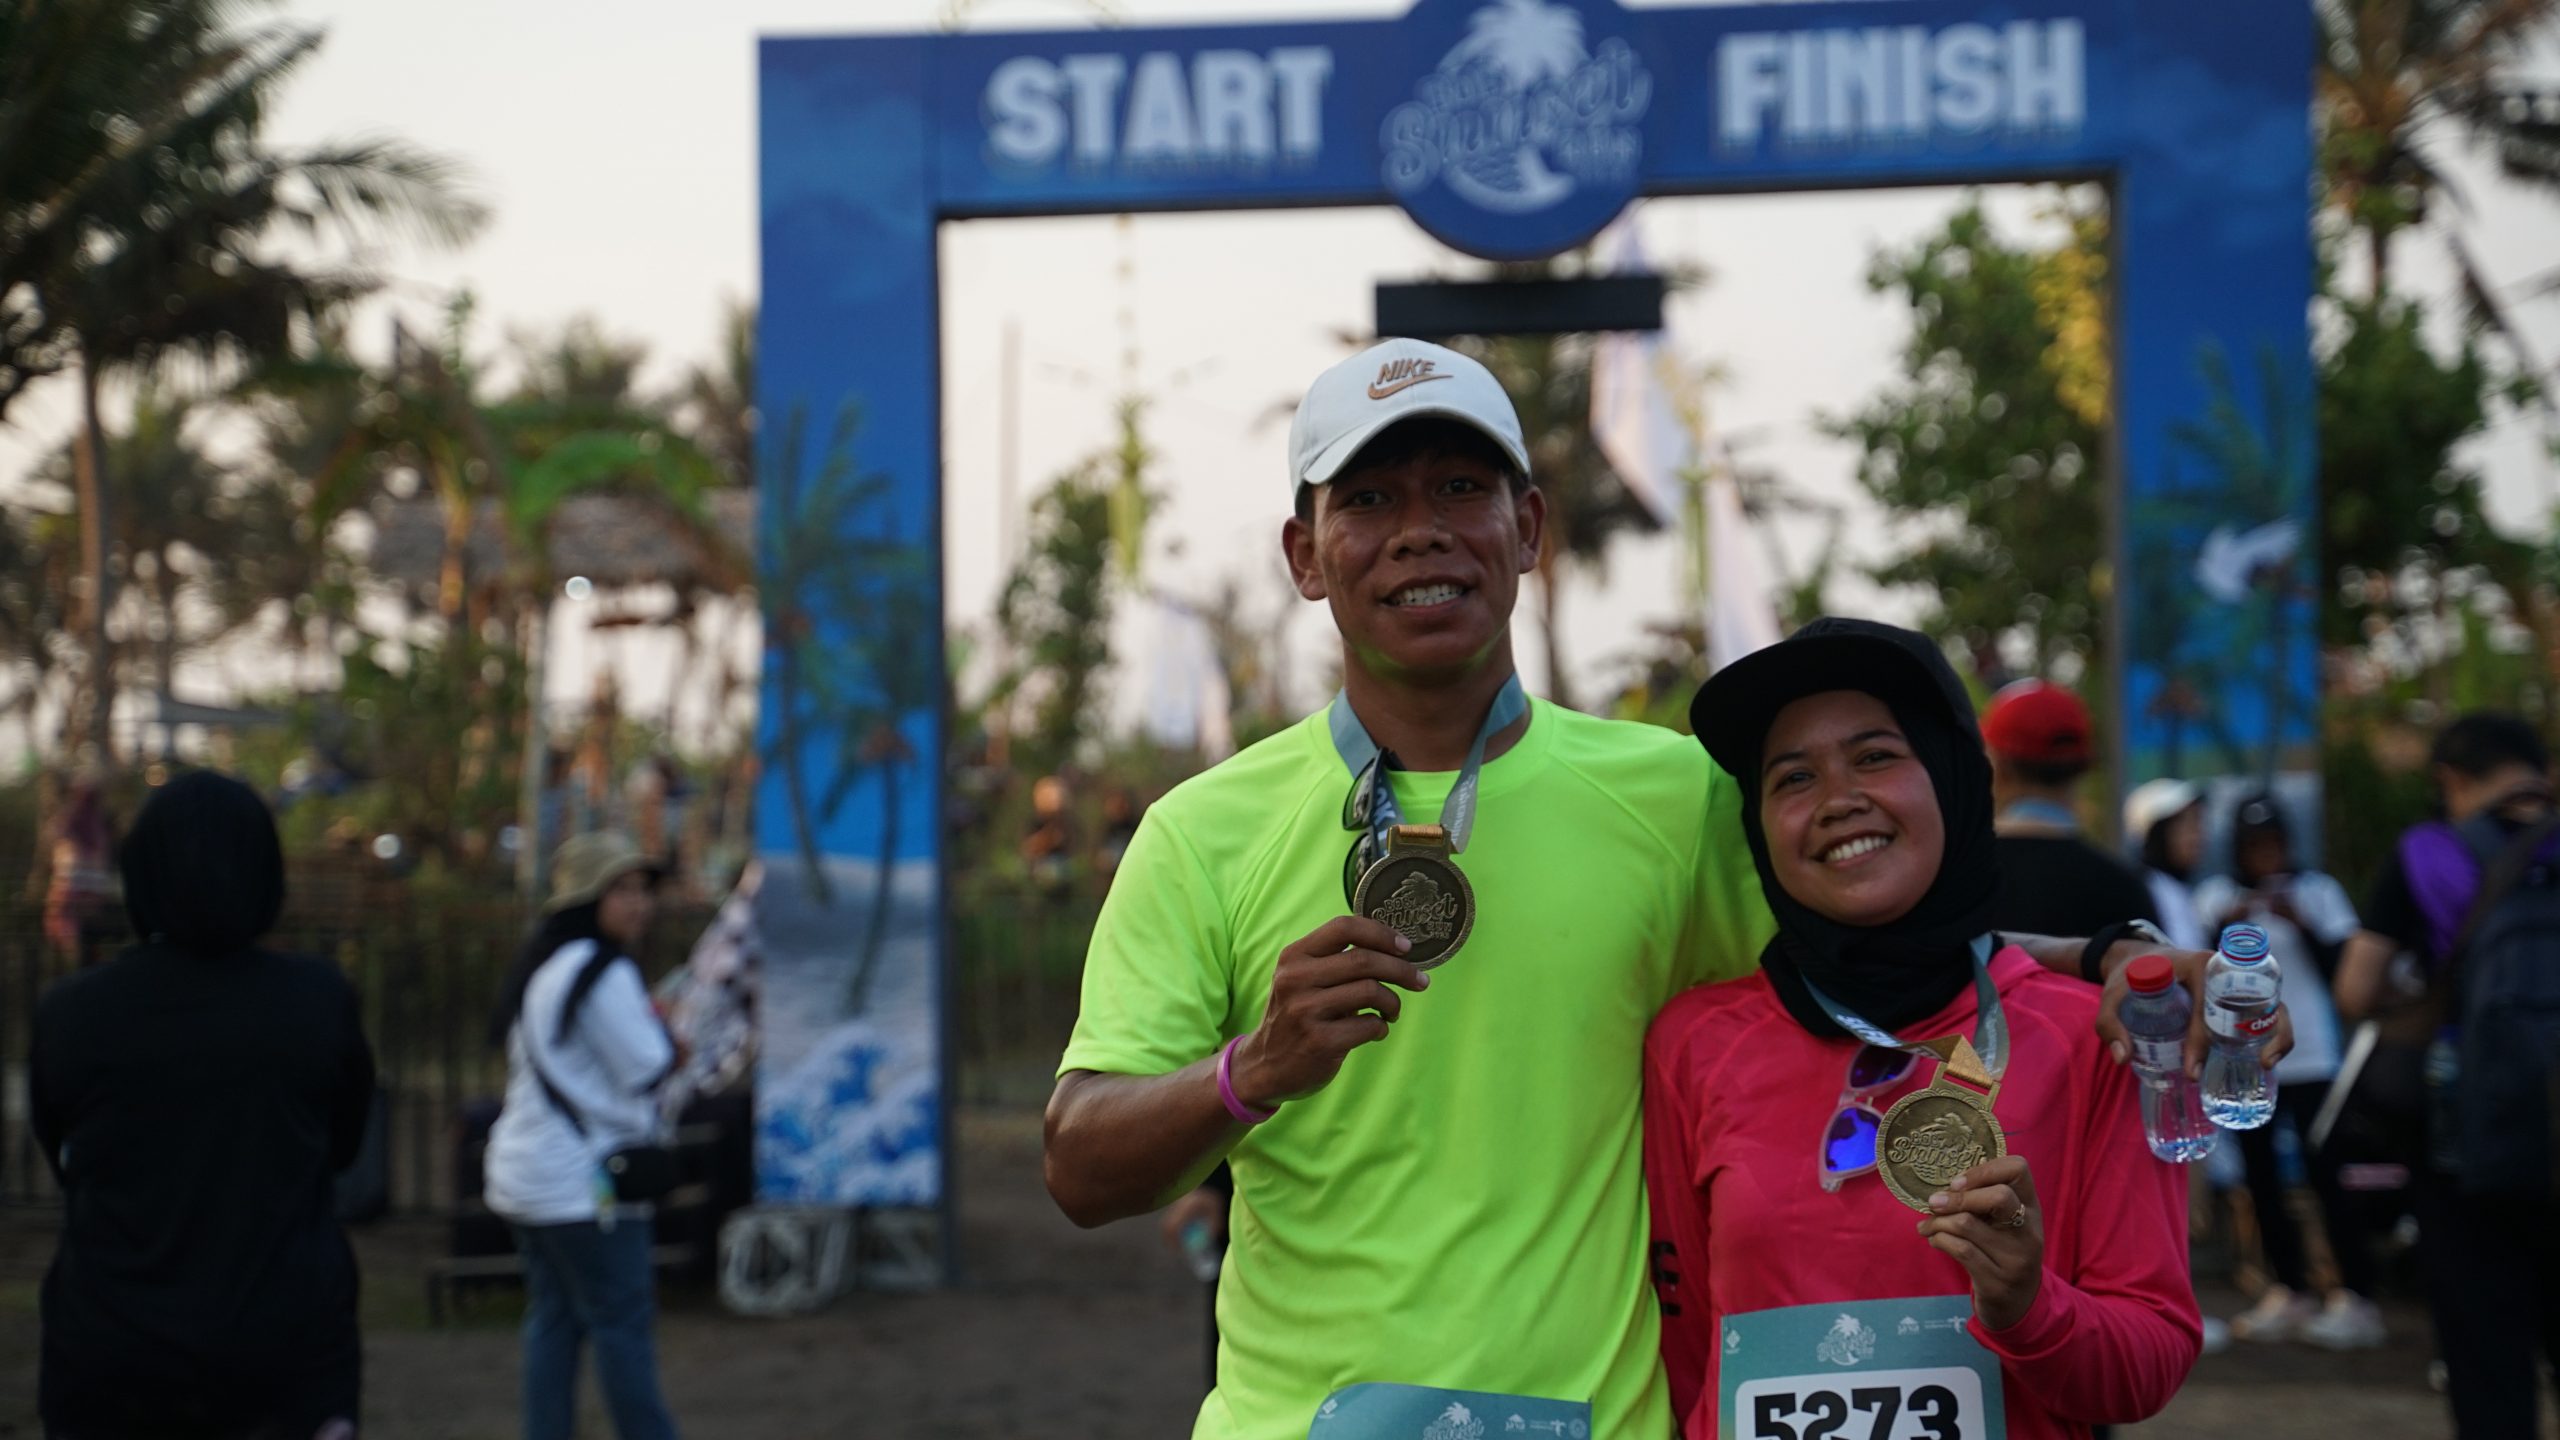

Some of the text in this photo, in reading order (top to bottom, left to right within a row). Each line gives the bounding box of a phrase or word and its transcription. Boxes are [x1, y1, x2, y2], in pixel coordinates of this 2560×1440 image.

[987, 46, 1334, 164] START
[1717, 18, 2086, 145] FINISH
[1376, 358, 1435, 386] NIKE
[1889, 1136, 1987, 1169] Sunset
[1754, 1384, 1962, 1440] 5273
